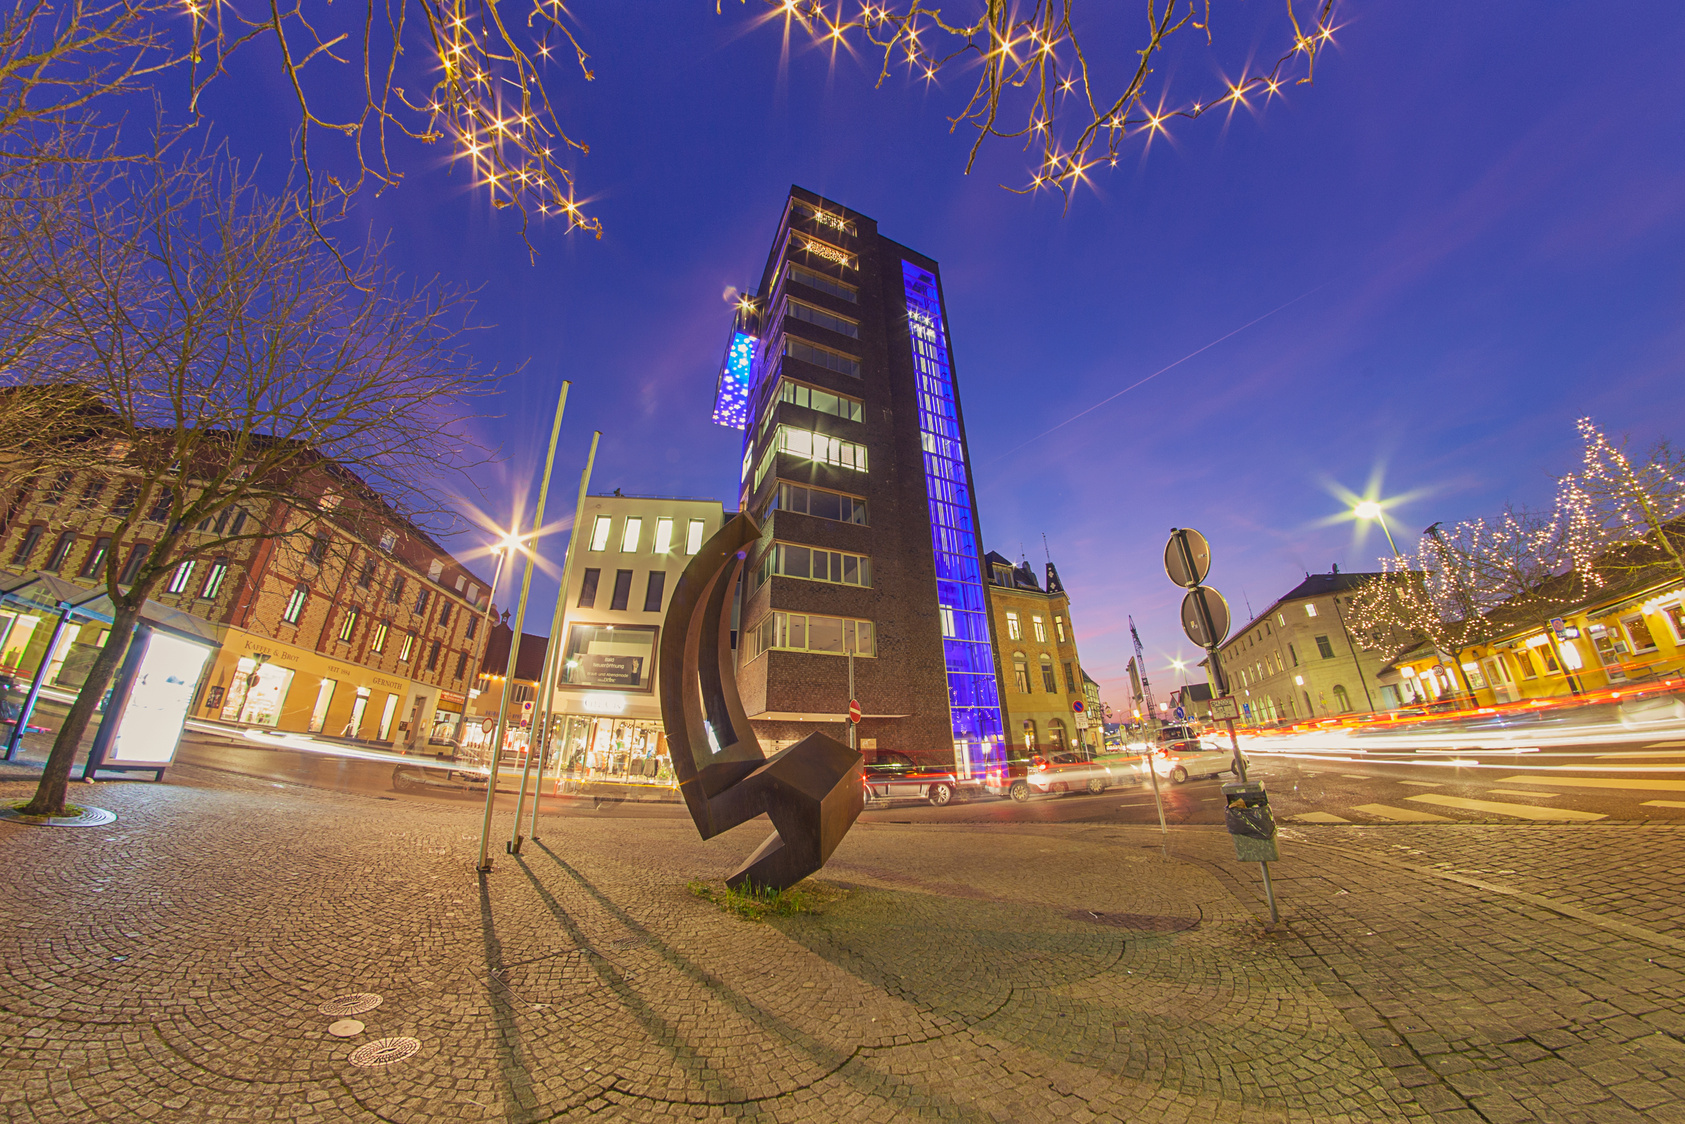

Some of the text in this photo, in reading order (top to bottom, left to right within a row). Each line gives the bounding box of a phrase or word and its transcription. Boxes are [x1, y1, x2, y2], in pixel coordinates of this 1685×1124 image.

[273, 649, 279, 657] &
[328, 665, 340, 673] SEIT
[373, 677, 402, 690] GERNOTH
